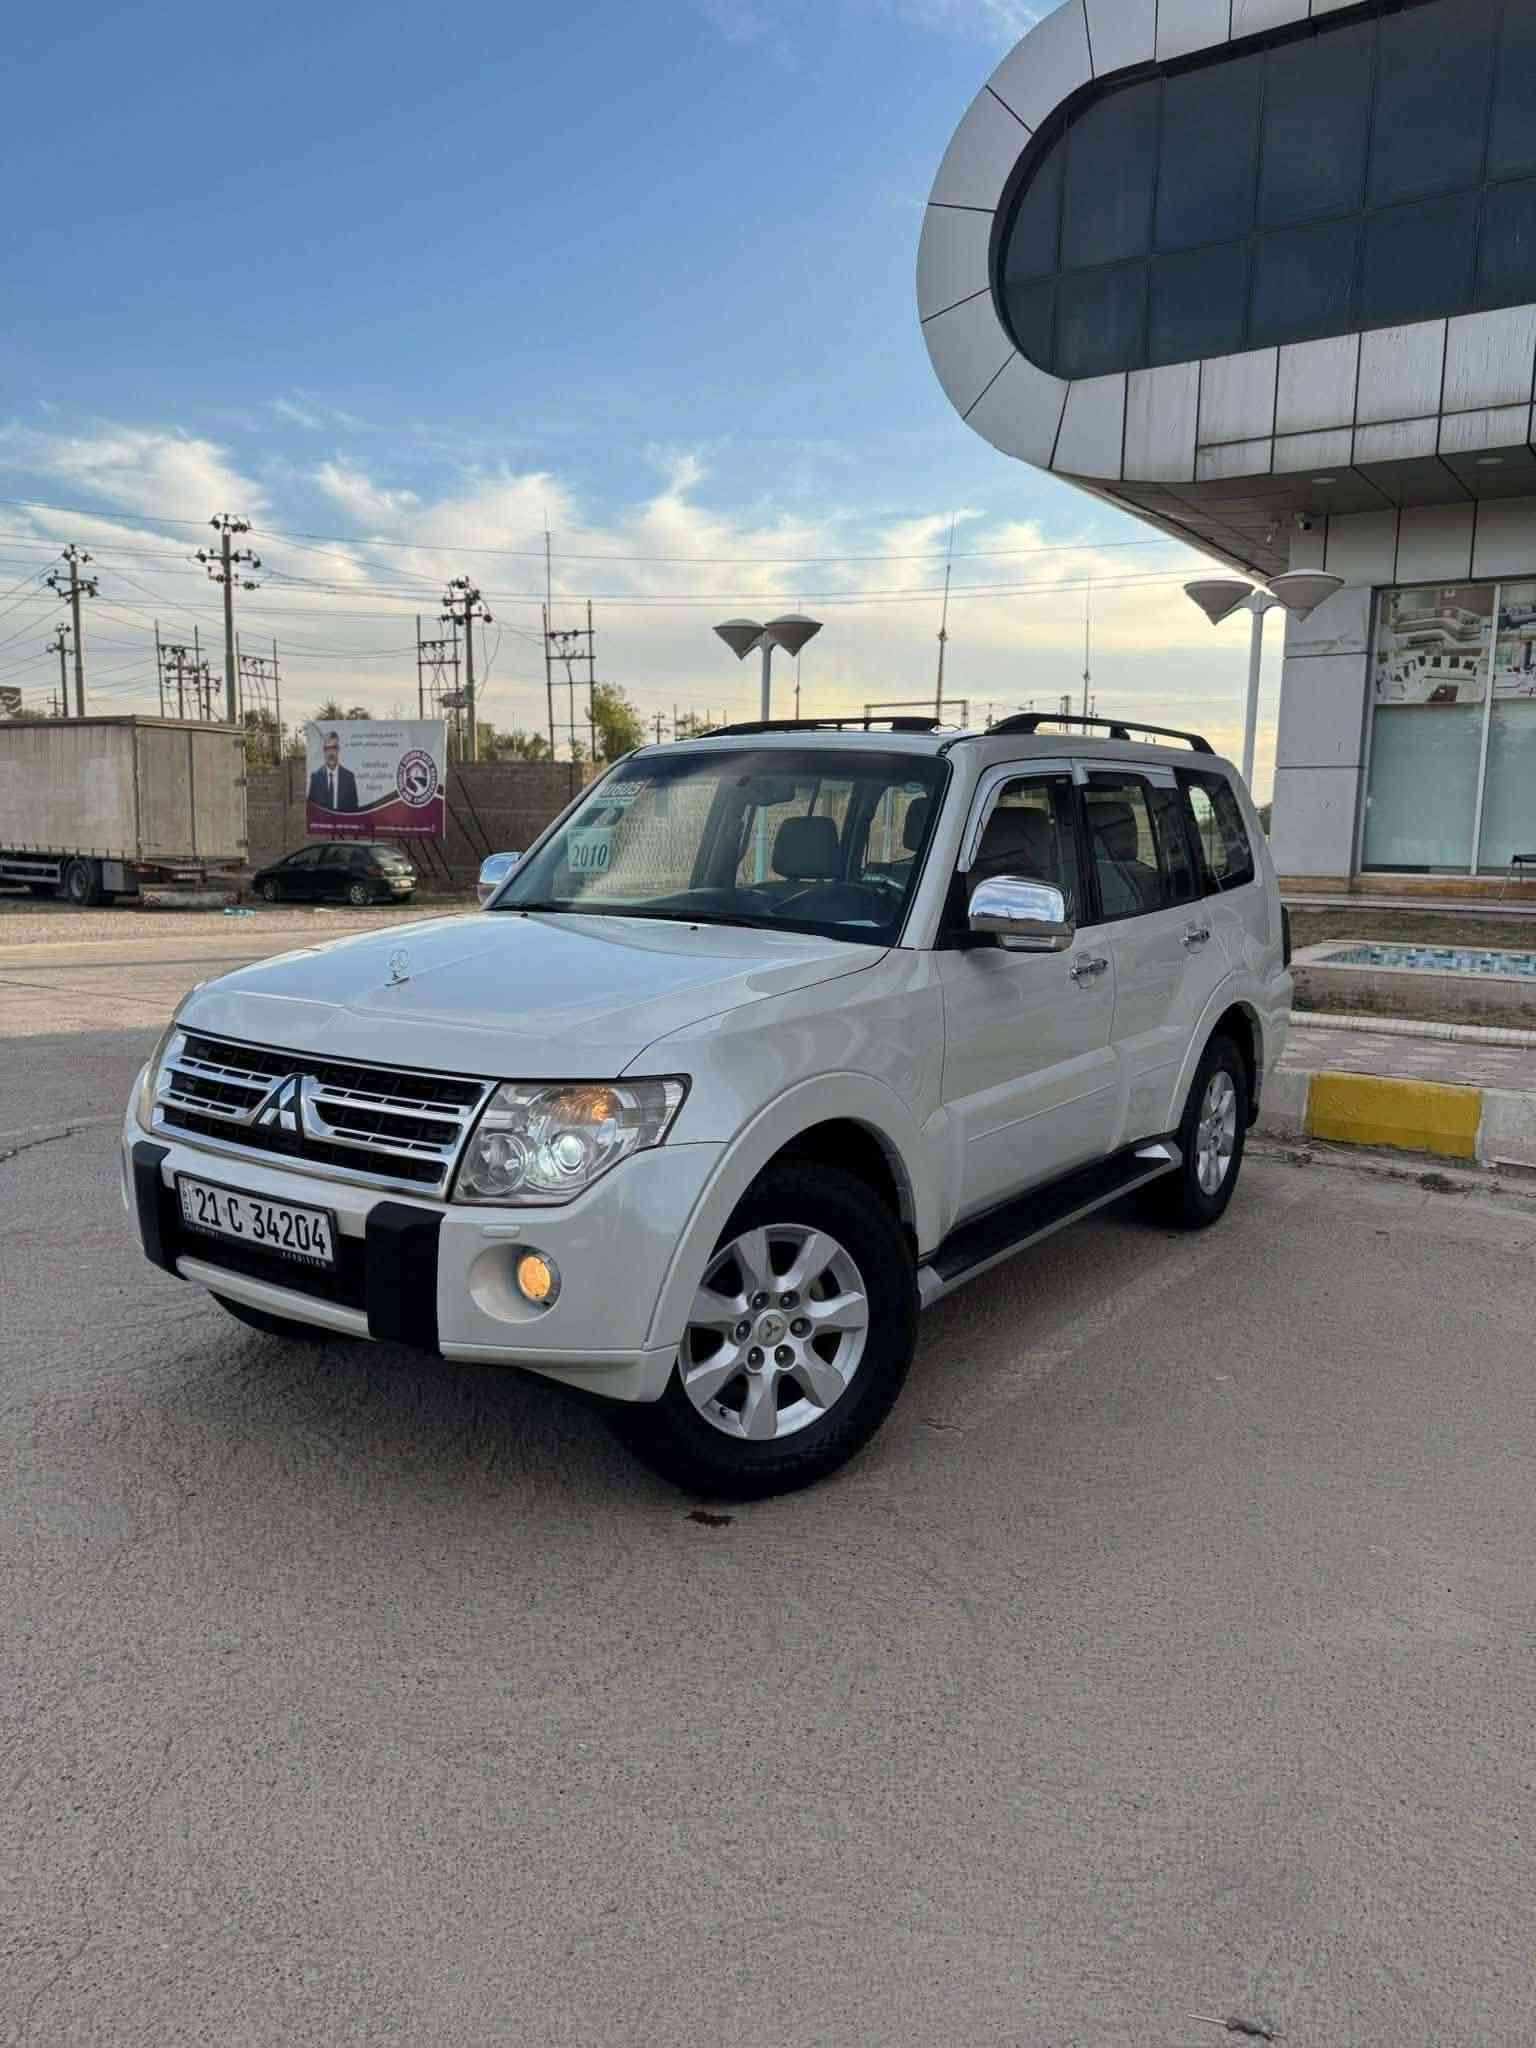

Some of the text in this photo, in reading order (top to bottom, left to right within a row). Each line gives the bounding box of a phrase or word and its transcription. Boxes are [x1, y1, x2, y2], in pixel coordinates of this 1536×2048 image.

[572, 843, 608, 867] 2010
[195, 1187, 222, 1227] 21
[227, 1197, 243, 1233] C
[249, 1203, 326, 1255] 34204
